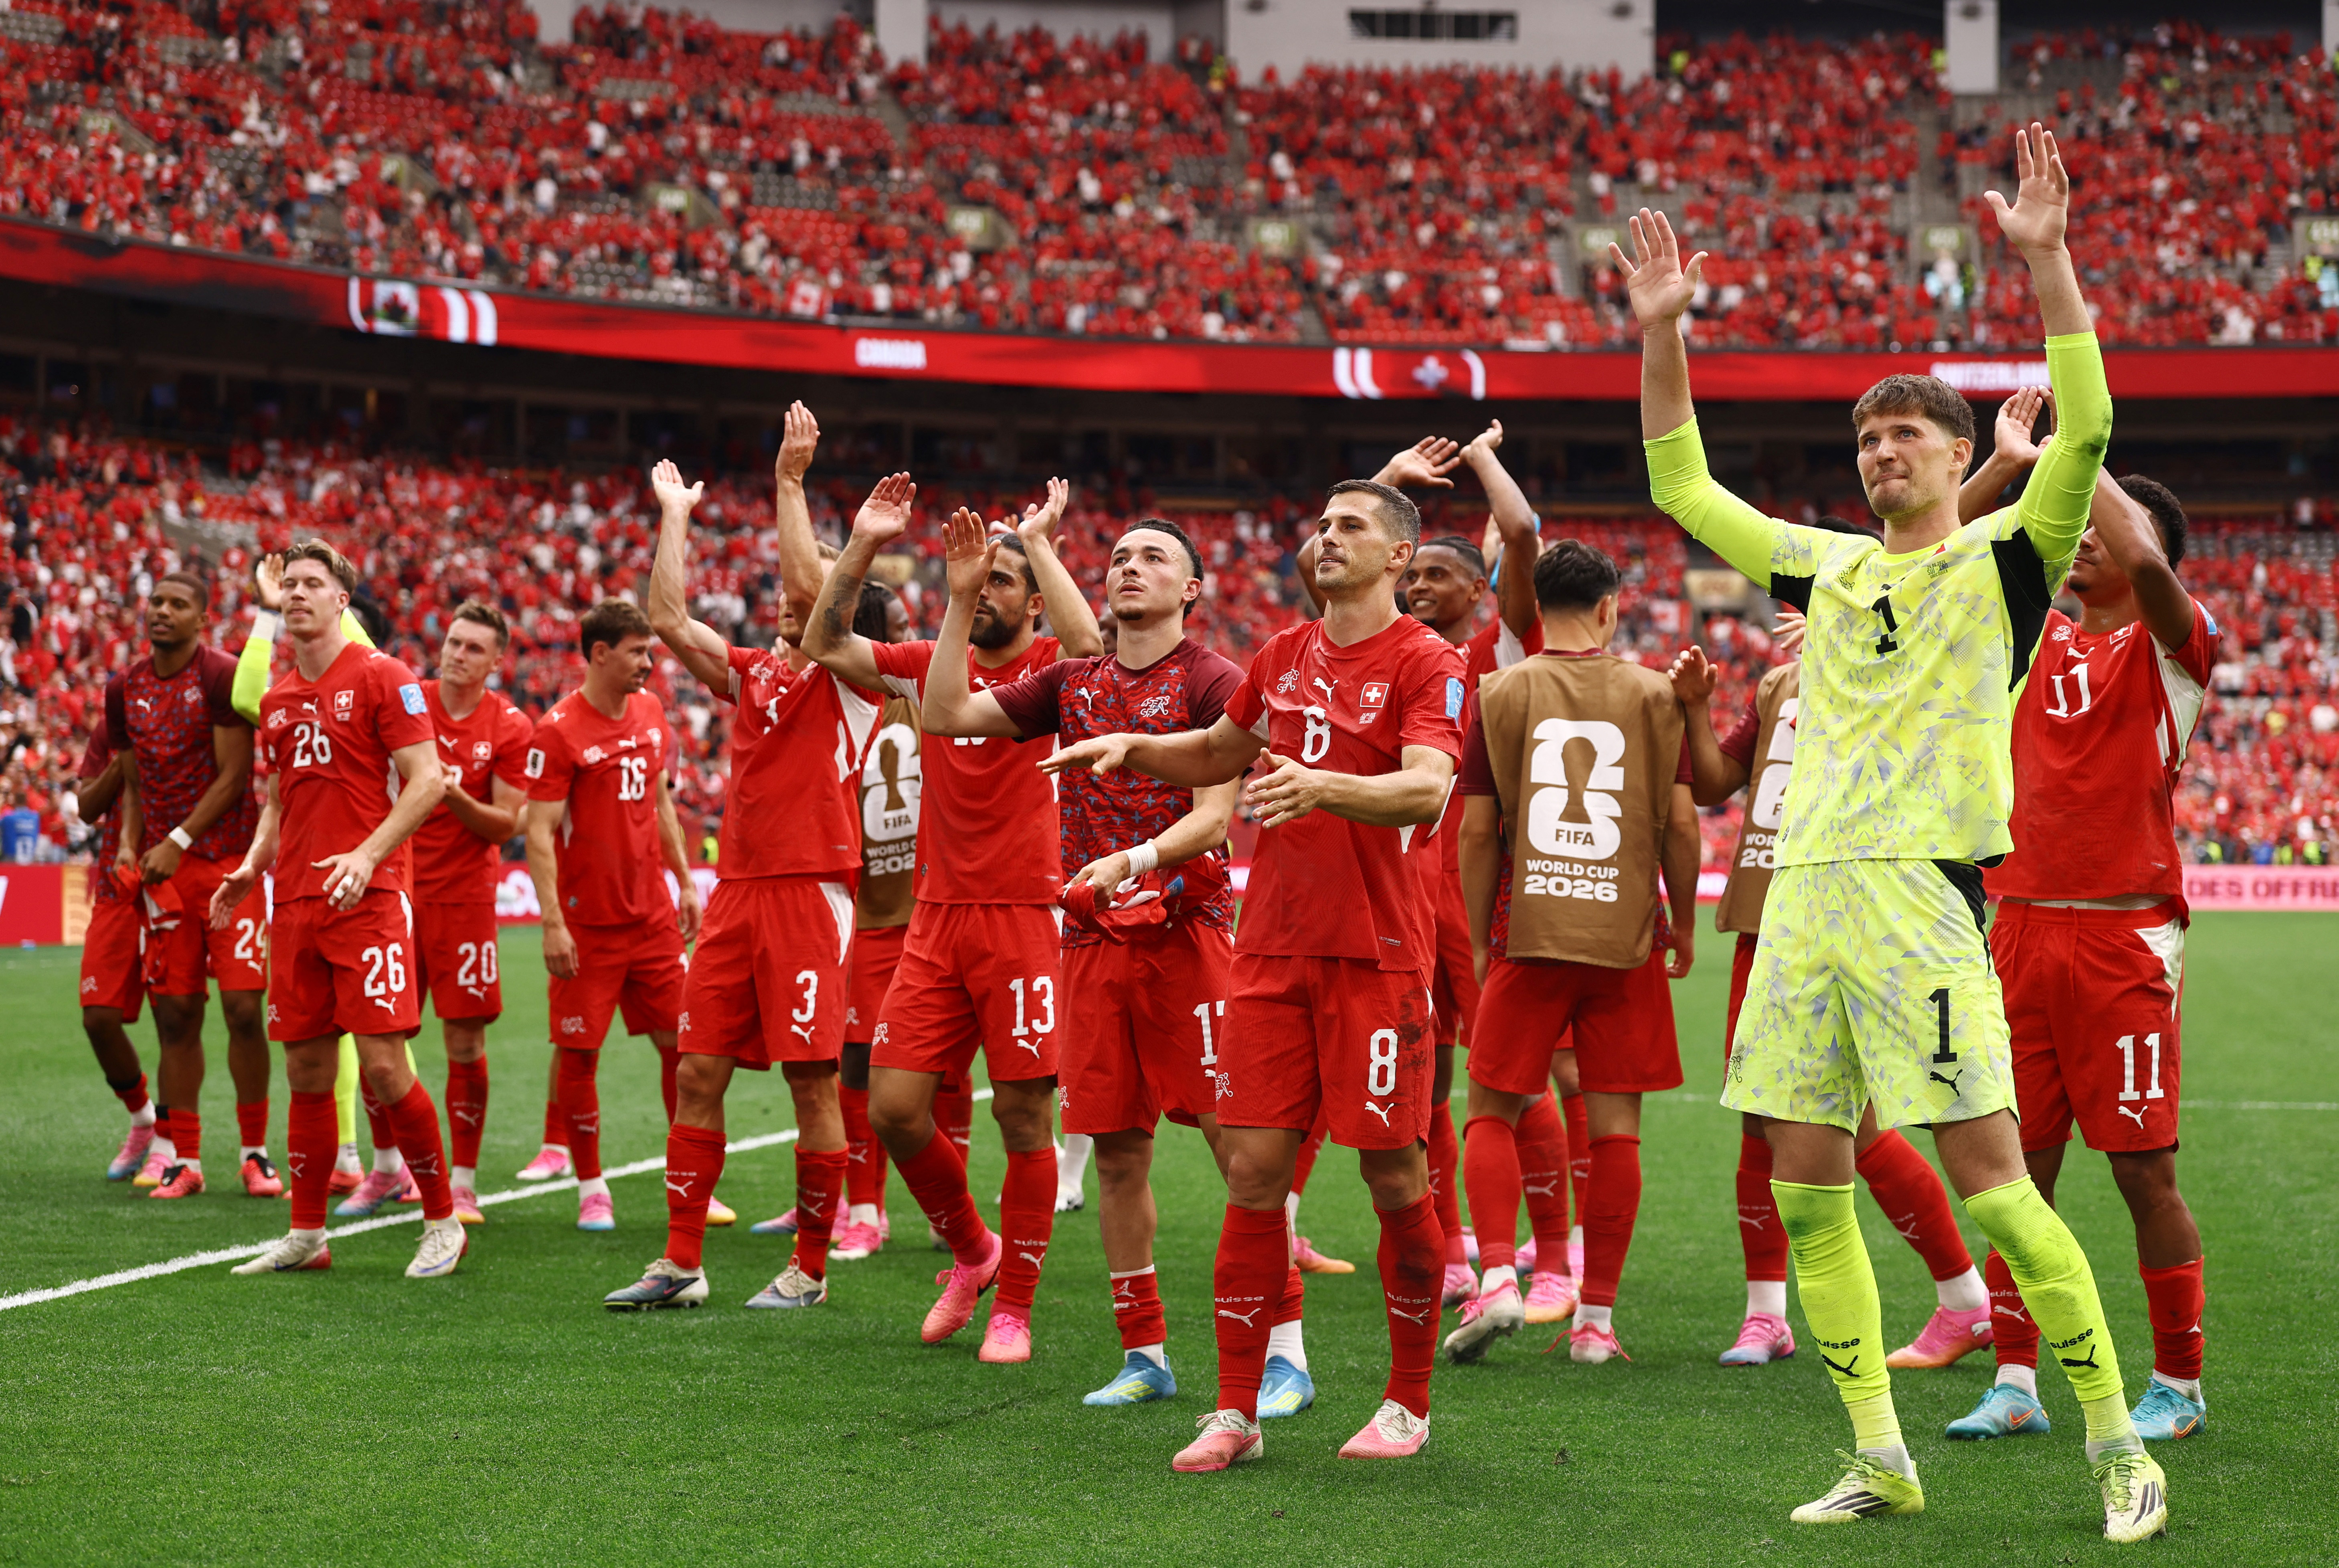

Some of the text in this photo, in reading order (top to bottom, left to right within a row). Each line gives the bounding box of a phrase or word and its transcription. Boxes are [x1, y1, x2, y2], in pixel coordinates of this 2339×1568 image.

[1871, 597, 1898, 654] 1
[2046, 663, 2090, 718] 11
[293, 720, 332, 768] 26
[1301, 706, 1331, 762] 8
[885, 815, 912, 830] FIFA
[1556, 829, 1595, 846] FIFA
[1746, 833, 1775, 847] WOR
[866, 841, 908, 858] WORLD
[868, 852, 916, 877] 202
[1740, 848, 1774, 869] 20
[1526, 859, 1619, 879] WORLD CUP
[1524, 874, 1618, 902] 2026
[362, 943, 406, 997] 26
[458, 941, 498, 986] 20
[792, 970, 818, 1022] 3
[1009, 976, 1054, 1036] 13
[1928, 988, 1957, 1063] 1
[1368, 1029, 1398, 1095] 8
[2116, 1033, 2164, 1101] 11
[1387, 1291, 1431, 1304] suisse
[1990, 1289, 2021, 1297] suiss
[2050, 1328, 2093, 1349] suisse
